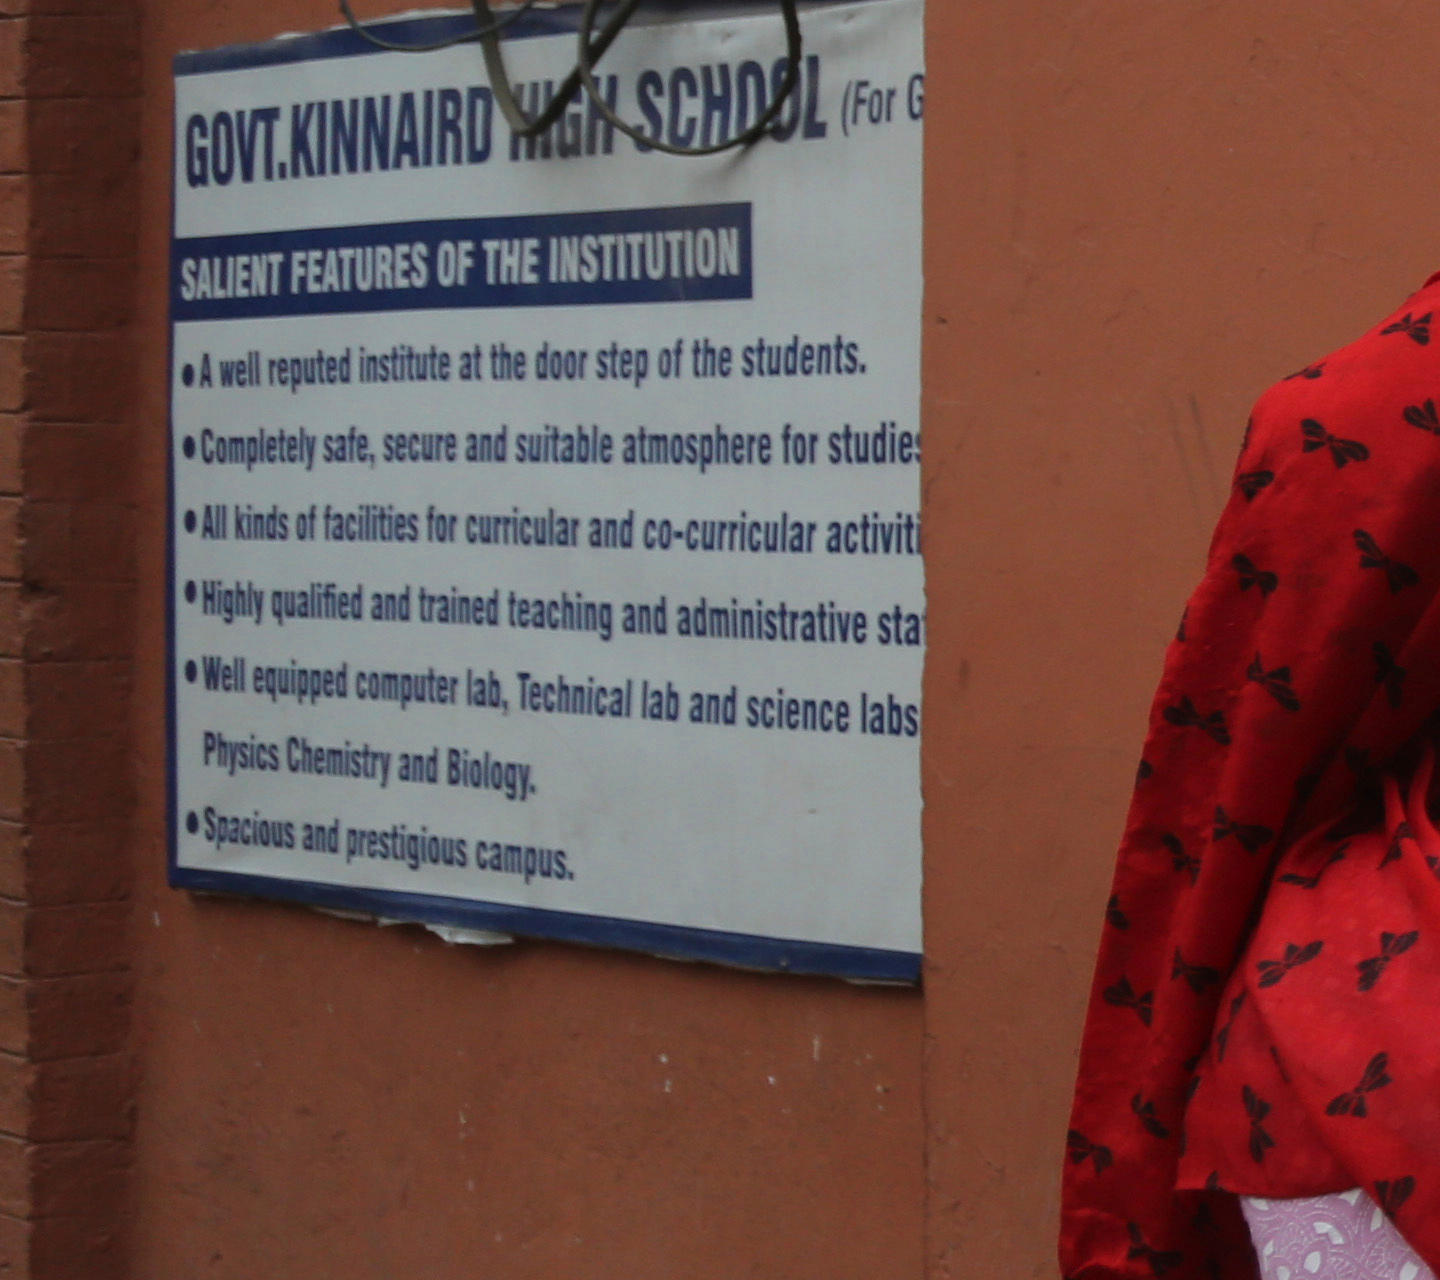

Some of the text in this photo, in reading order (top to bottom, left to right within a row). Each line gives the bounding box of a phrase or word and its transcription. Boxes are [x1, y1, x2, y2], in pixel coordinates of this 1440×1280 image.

[185, 86, 493, 190] GOVT.KINNAIRD
[508, 74, 618, 162] HIGH
[634, 55, 827, 153] SCHOOL
[841, 79, 896, 138] (For
[180, 226, 741, 301] SALIENT FEATURES OF THE INSTITUTION
[200, 334, 867, 395] A well reputed institute at the door step of the students.
[200, 427, 316, 472] Completely
[322, 426, 377, 468] safe,
[383, 431, 457, 463] secure
[465, 425, 507, 463] and
[515, 424, 613, 465] suitable
[622, 424, 772, 474] atmosphere
[782, 423, 818, 465] for
[201, 504, 228, 541] All
[235, 505, 289, 542] kinds
[296, 504, 317, 541] of
[324, 504, 419, 542] facilities
[427, 505, 457, 543] for
[465, 507, 580, 547] curricular
[588, 509, 634, 549] and
[643, 509, 817, 554] co-curricular
[202, 580, 926, 646] Highly qualified and trained teaching and administrative sta
[202, 655, 919, 738] Well equipped computer lab, Technical lab and science labs
[203, 731, 538, 801] Physics Chemistry and Biology.
[203, 806, 575, 885] Spacious and prestigious campus.
